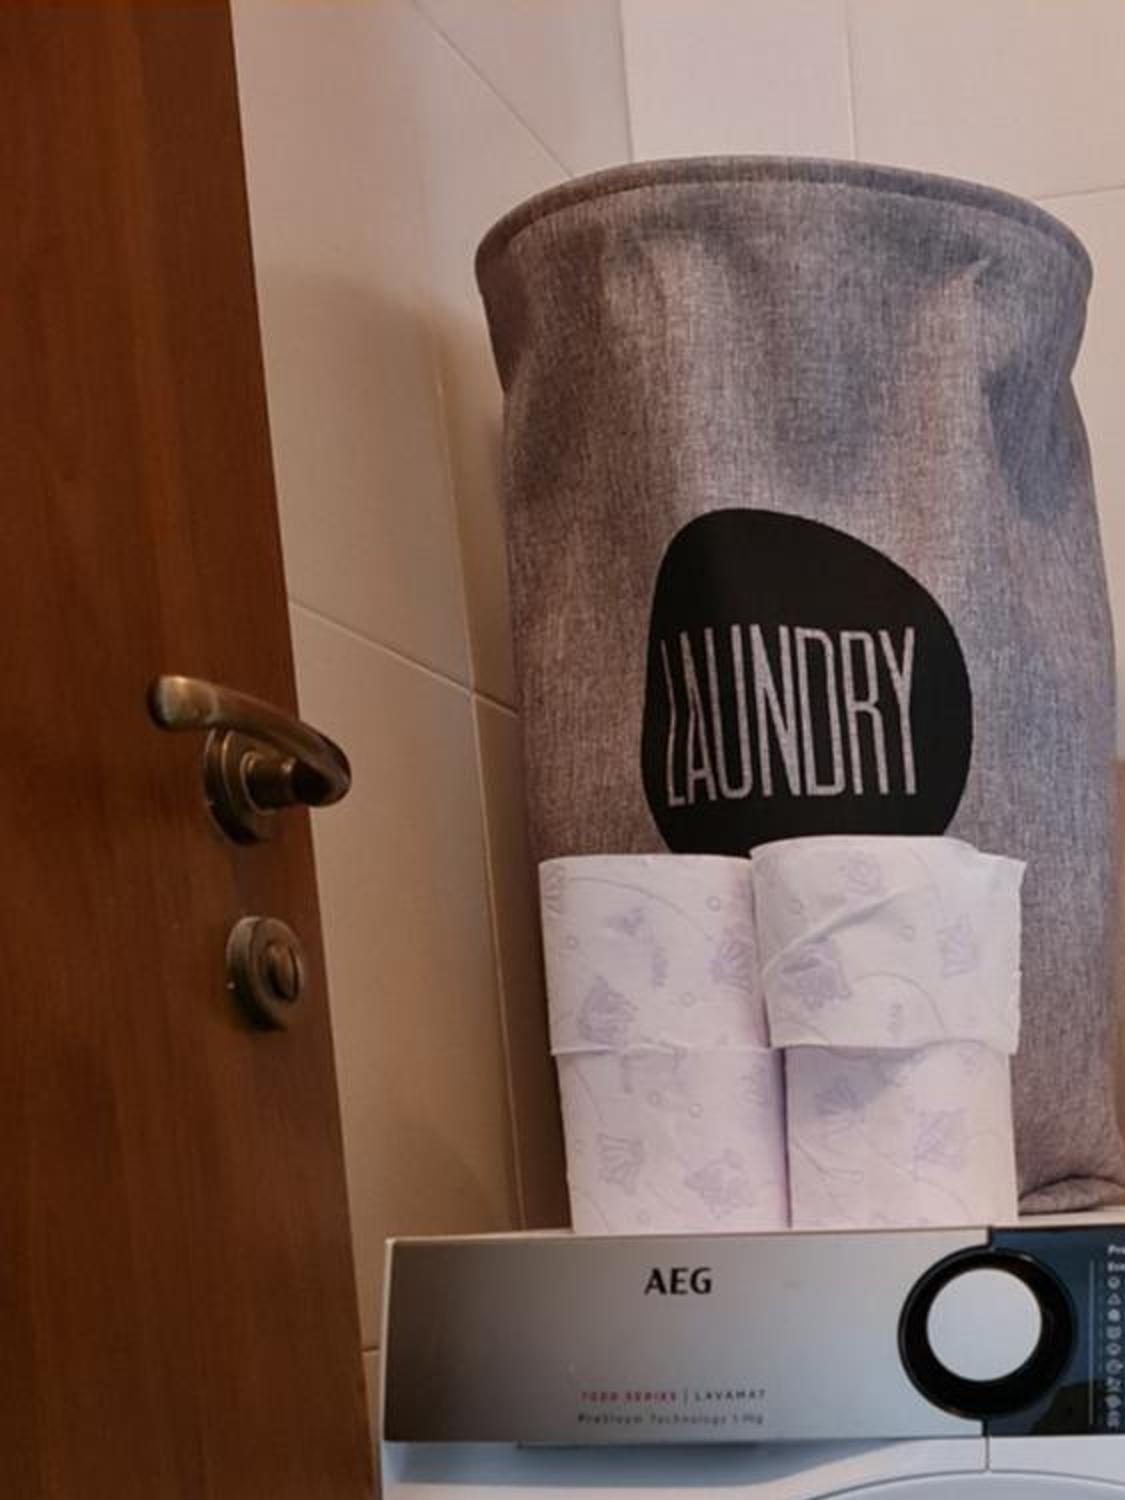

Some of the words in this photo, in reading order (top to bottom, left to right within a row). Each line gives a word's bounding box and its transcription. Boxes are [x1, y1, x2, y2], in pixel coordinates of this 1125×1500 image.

[660, 623, 918, 808] LAUNDRY
[644, 1266, 713, 1295] AEG
[694, 1388, 767, 1402] LAVAMAT
